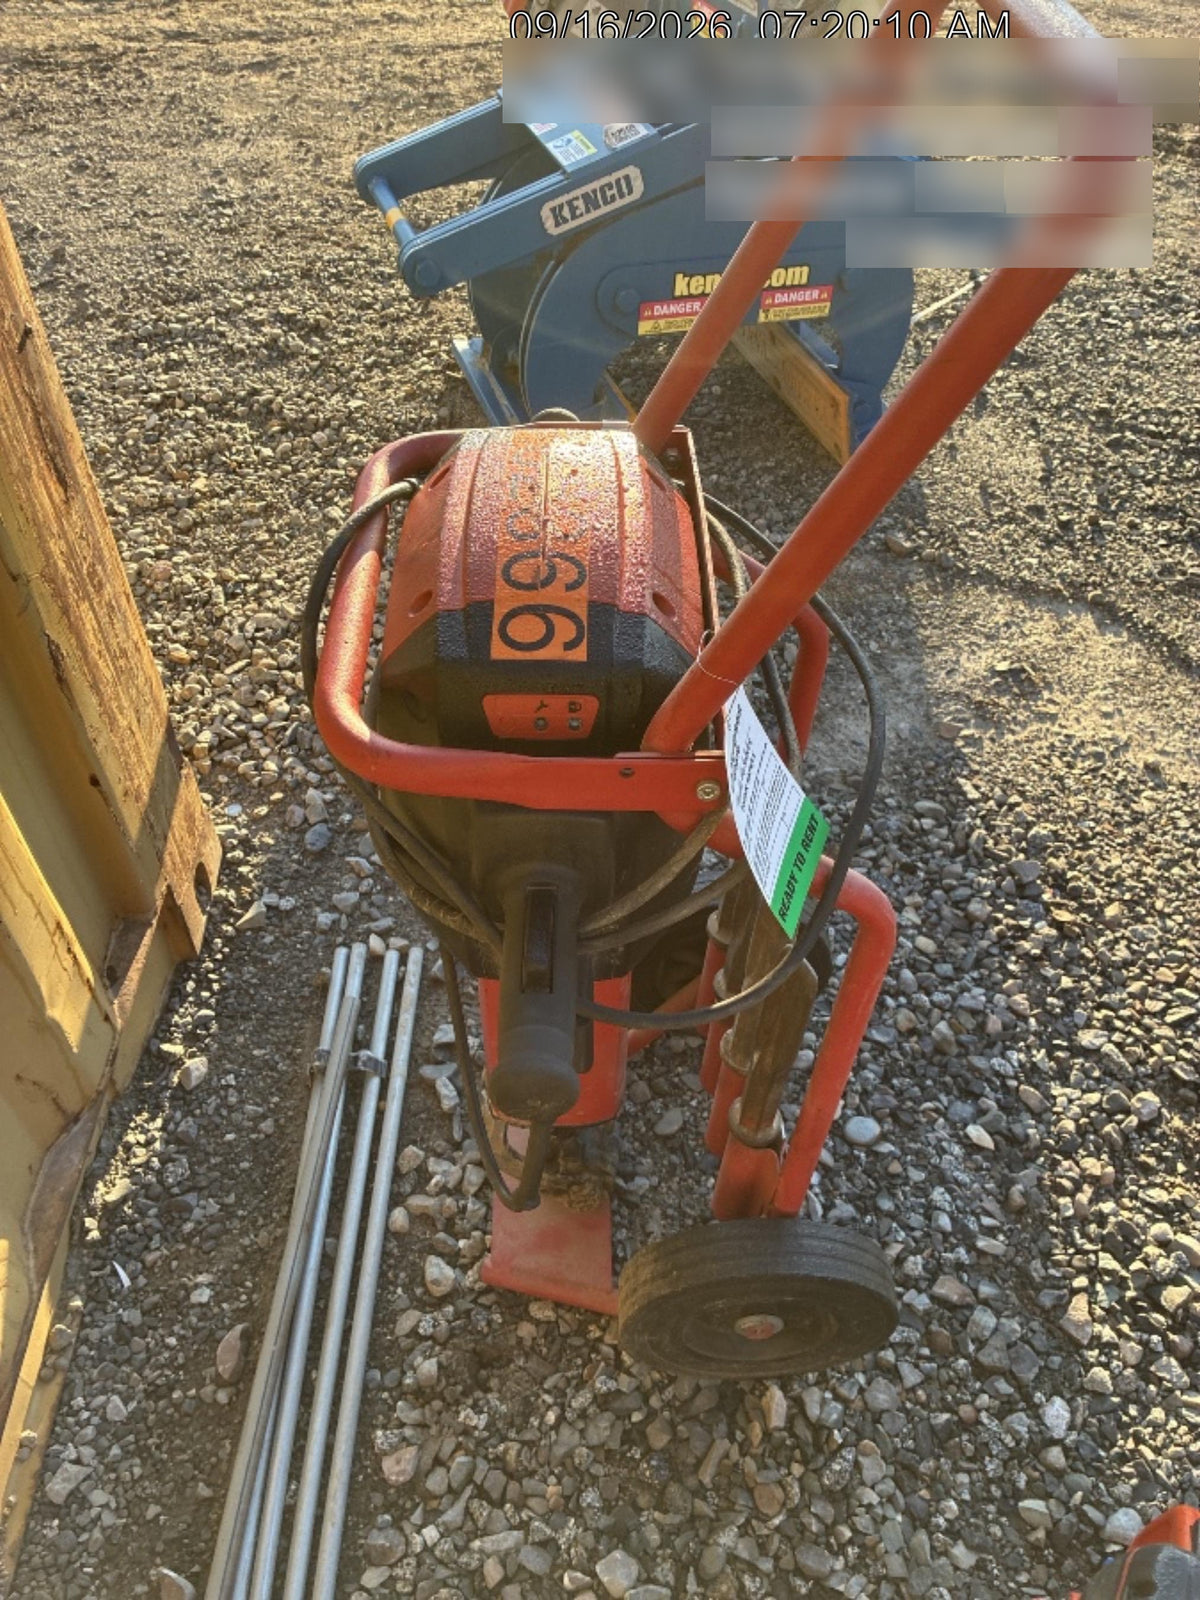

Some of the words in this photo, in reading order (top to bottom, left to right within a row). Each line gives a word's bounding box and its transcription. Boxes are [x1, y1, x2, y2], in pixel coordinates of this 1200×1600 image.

[549, 173, 634, 228] KENCO
[653, 301, 702, 316] DANGER
[774, 289, 819, 304] DANGER
[778, 873, 799, 923] READY
[794, 853, 806, 873] TO
[802, 813, 819, 850] RENT
